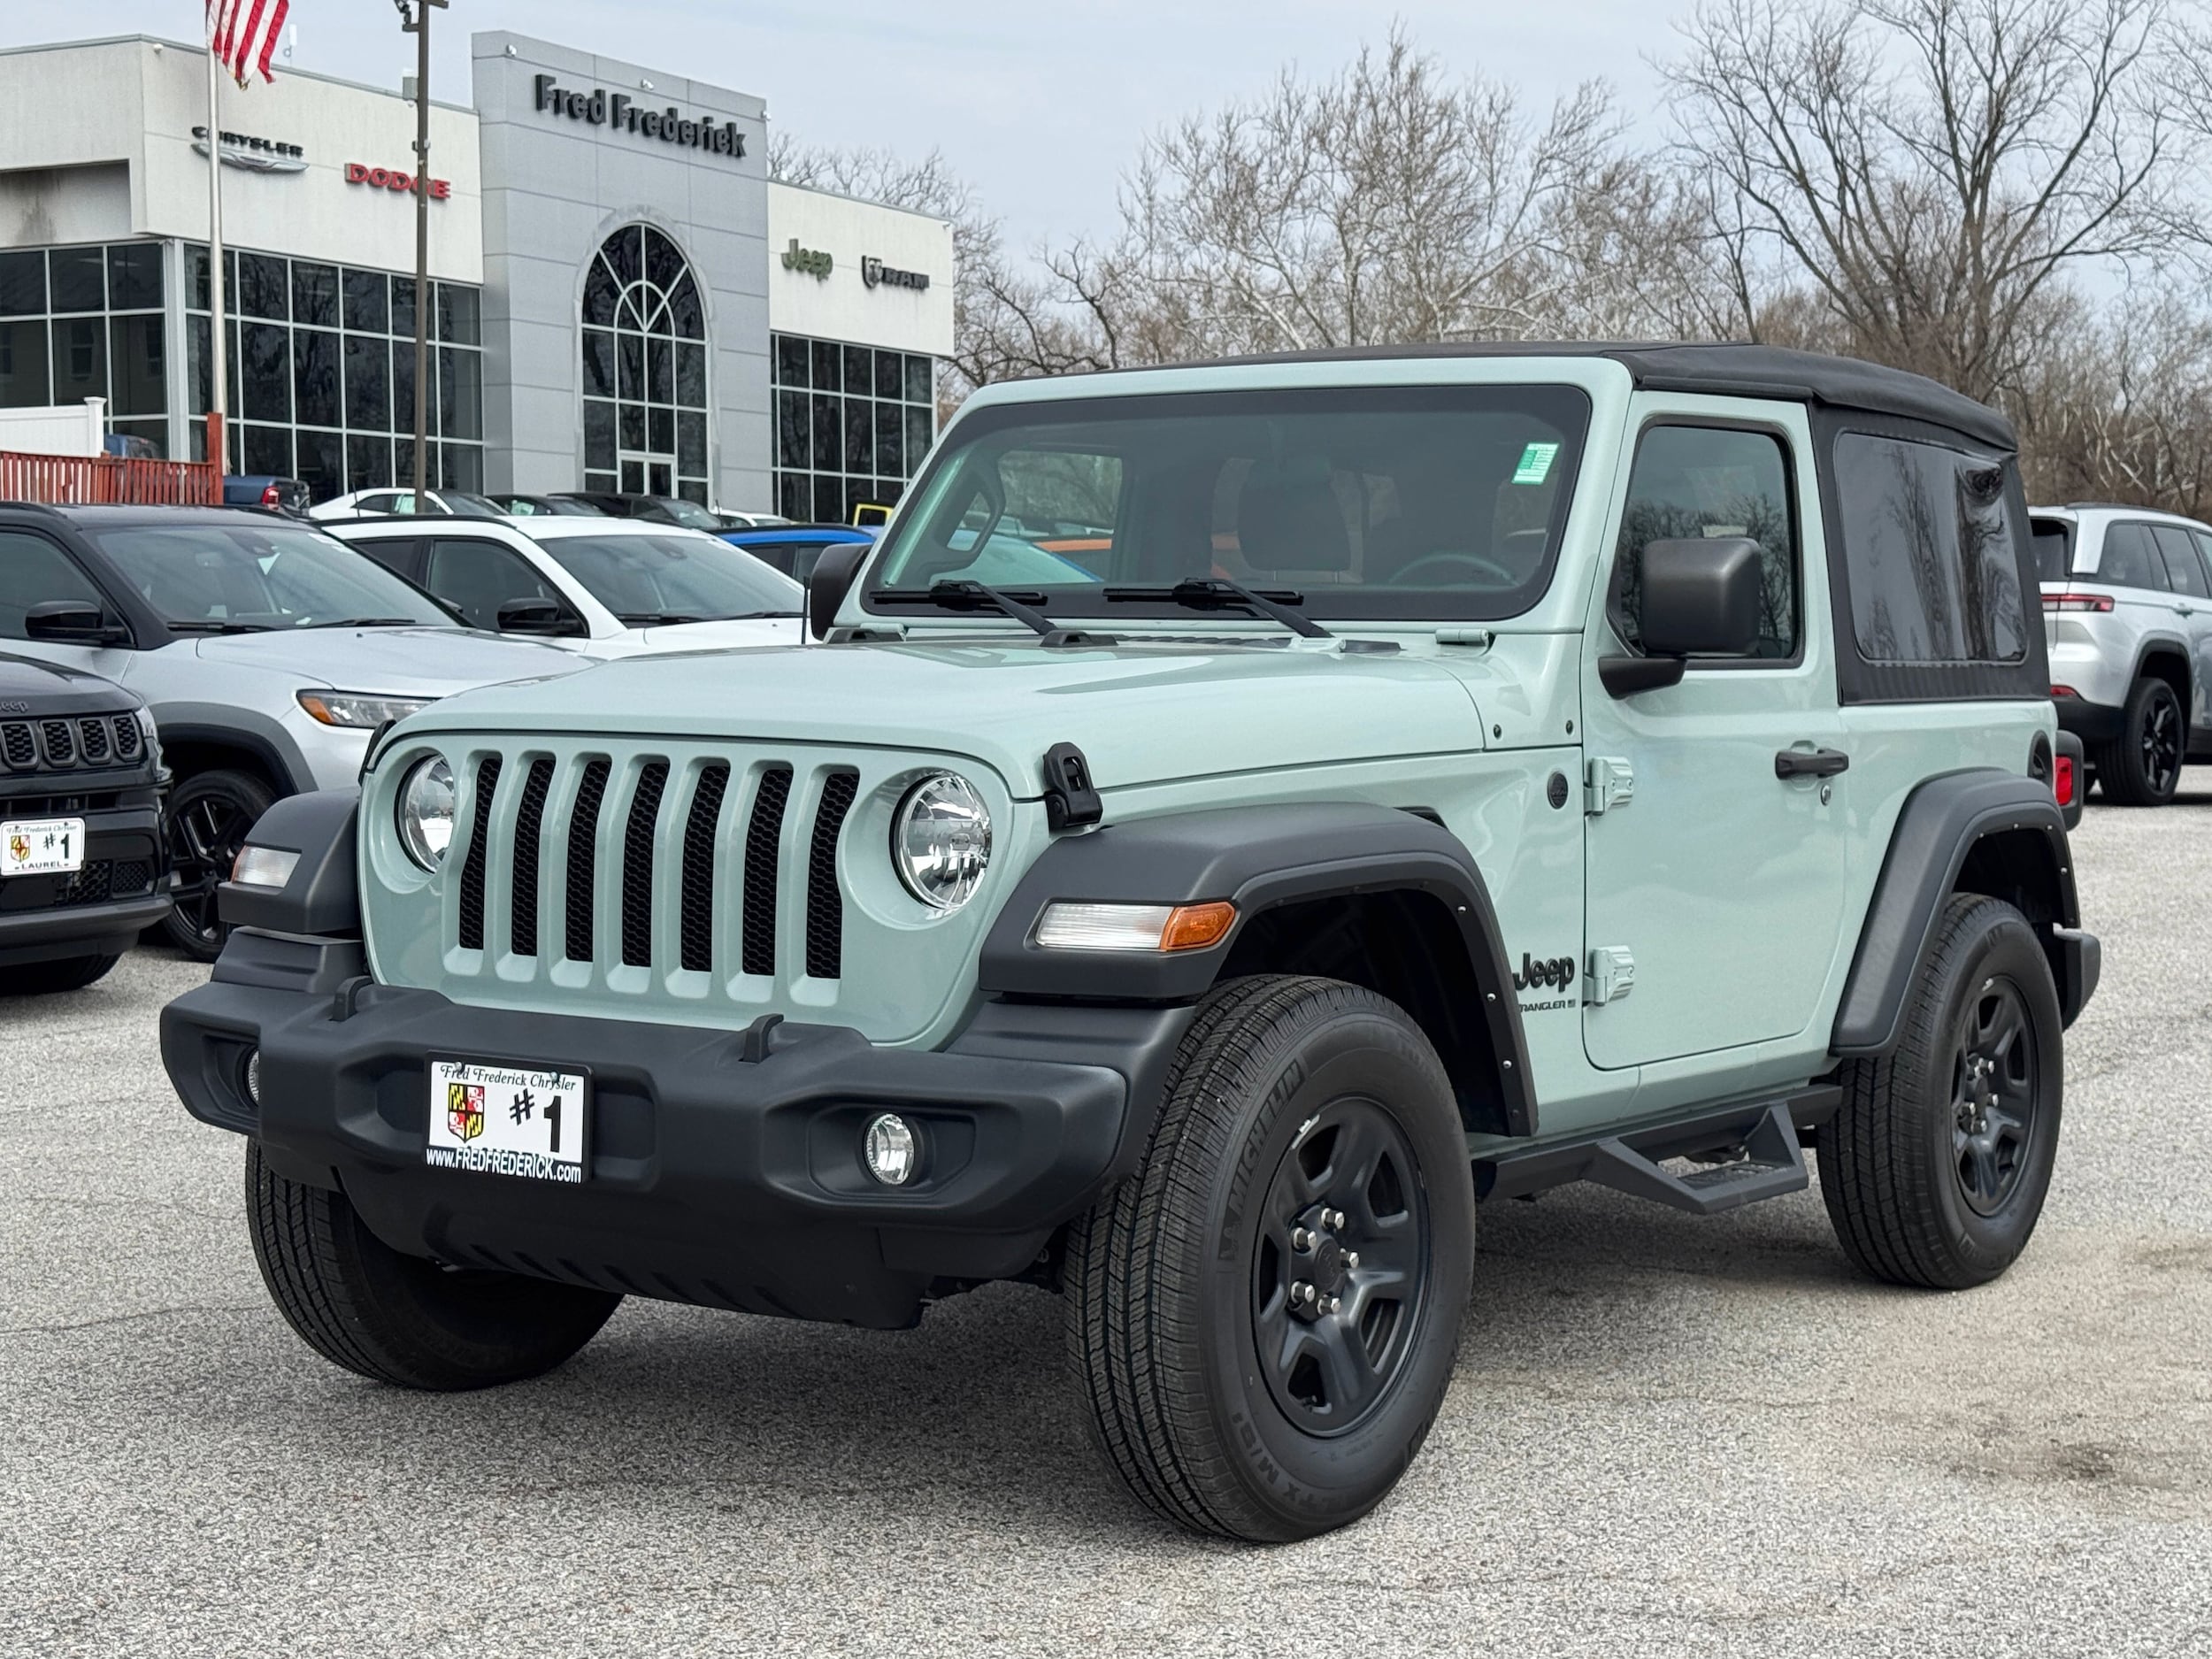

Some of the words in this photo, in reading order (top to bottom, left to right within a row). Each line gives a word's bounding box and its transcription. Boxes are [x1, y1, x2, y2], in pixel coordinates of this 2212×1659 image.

[534, 73, 606, 125] Fred
[611, 93, 746, 157] Frederick
[780, 238, 833, 281] Jeep
[882, 267, 930, 290] RAM
[0, 700, 28, 713] eep
[1512, 952, 1575, 993] Jeep
[1518, 999, 1566, 1012] RANGLER
[440, 1064, 470, 1080] Fred
[472, 1068, 527, 1087] Frederick
[530, 1073, 577, 1091] Chrysler
[426, 1148, 582, 1184] www.FREDFREDERICK.com
